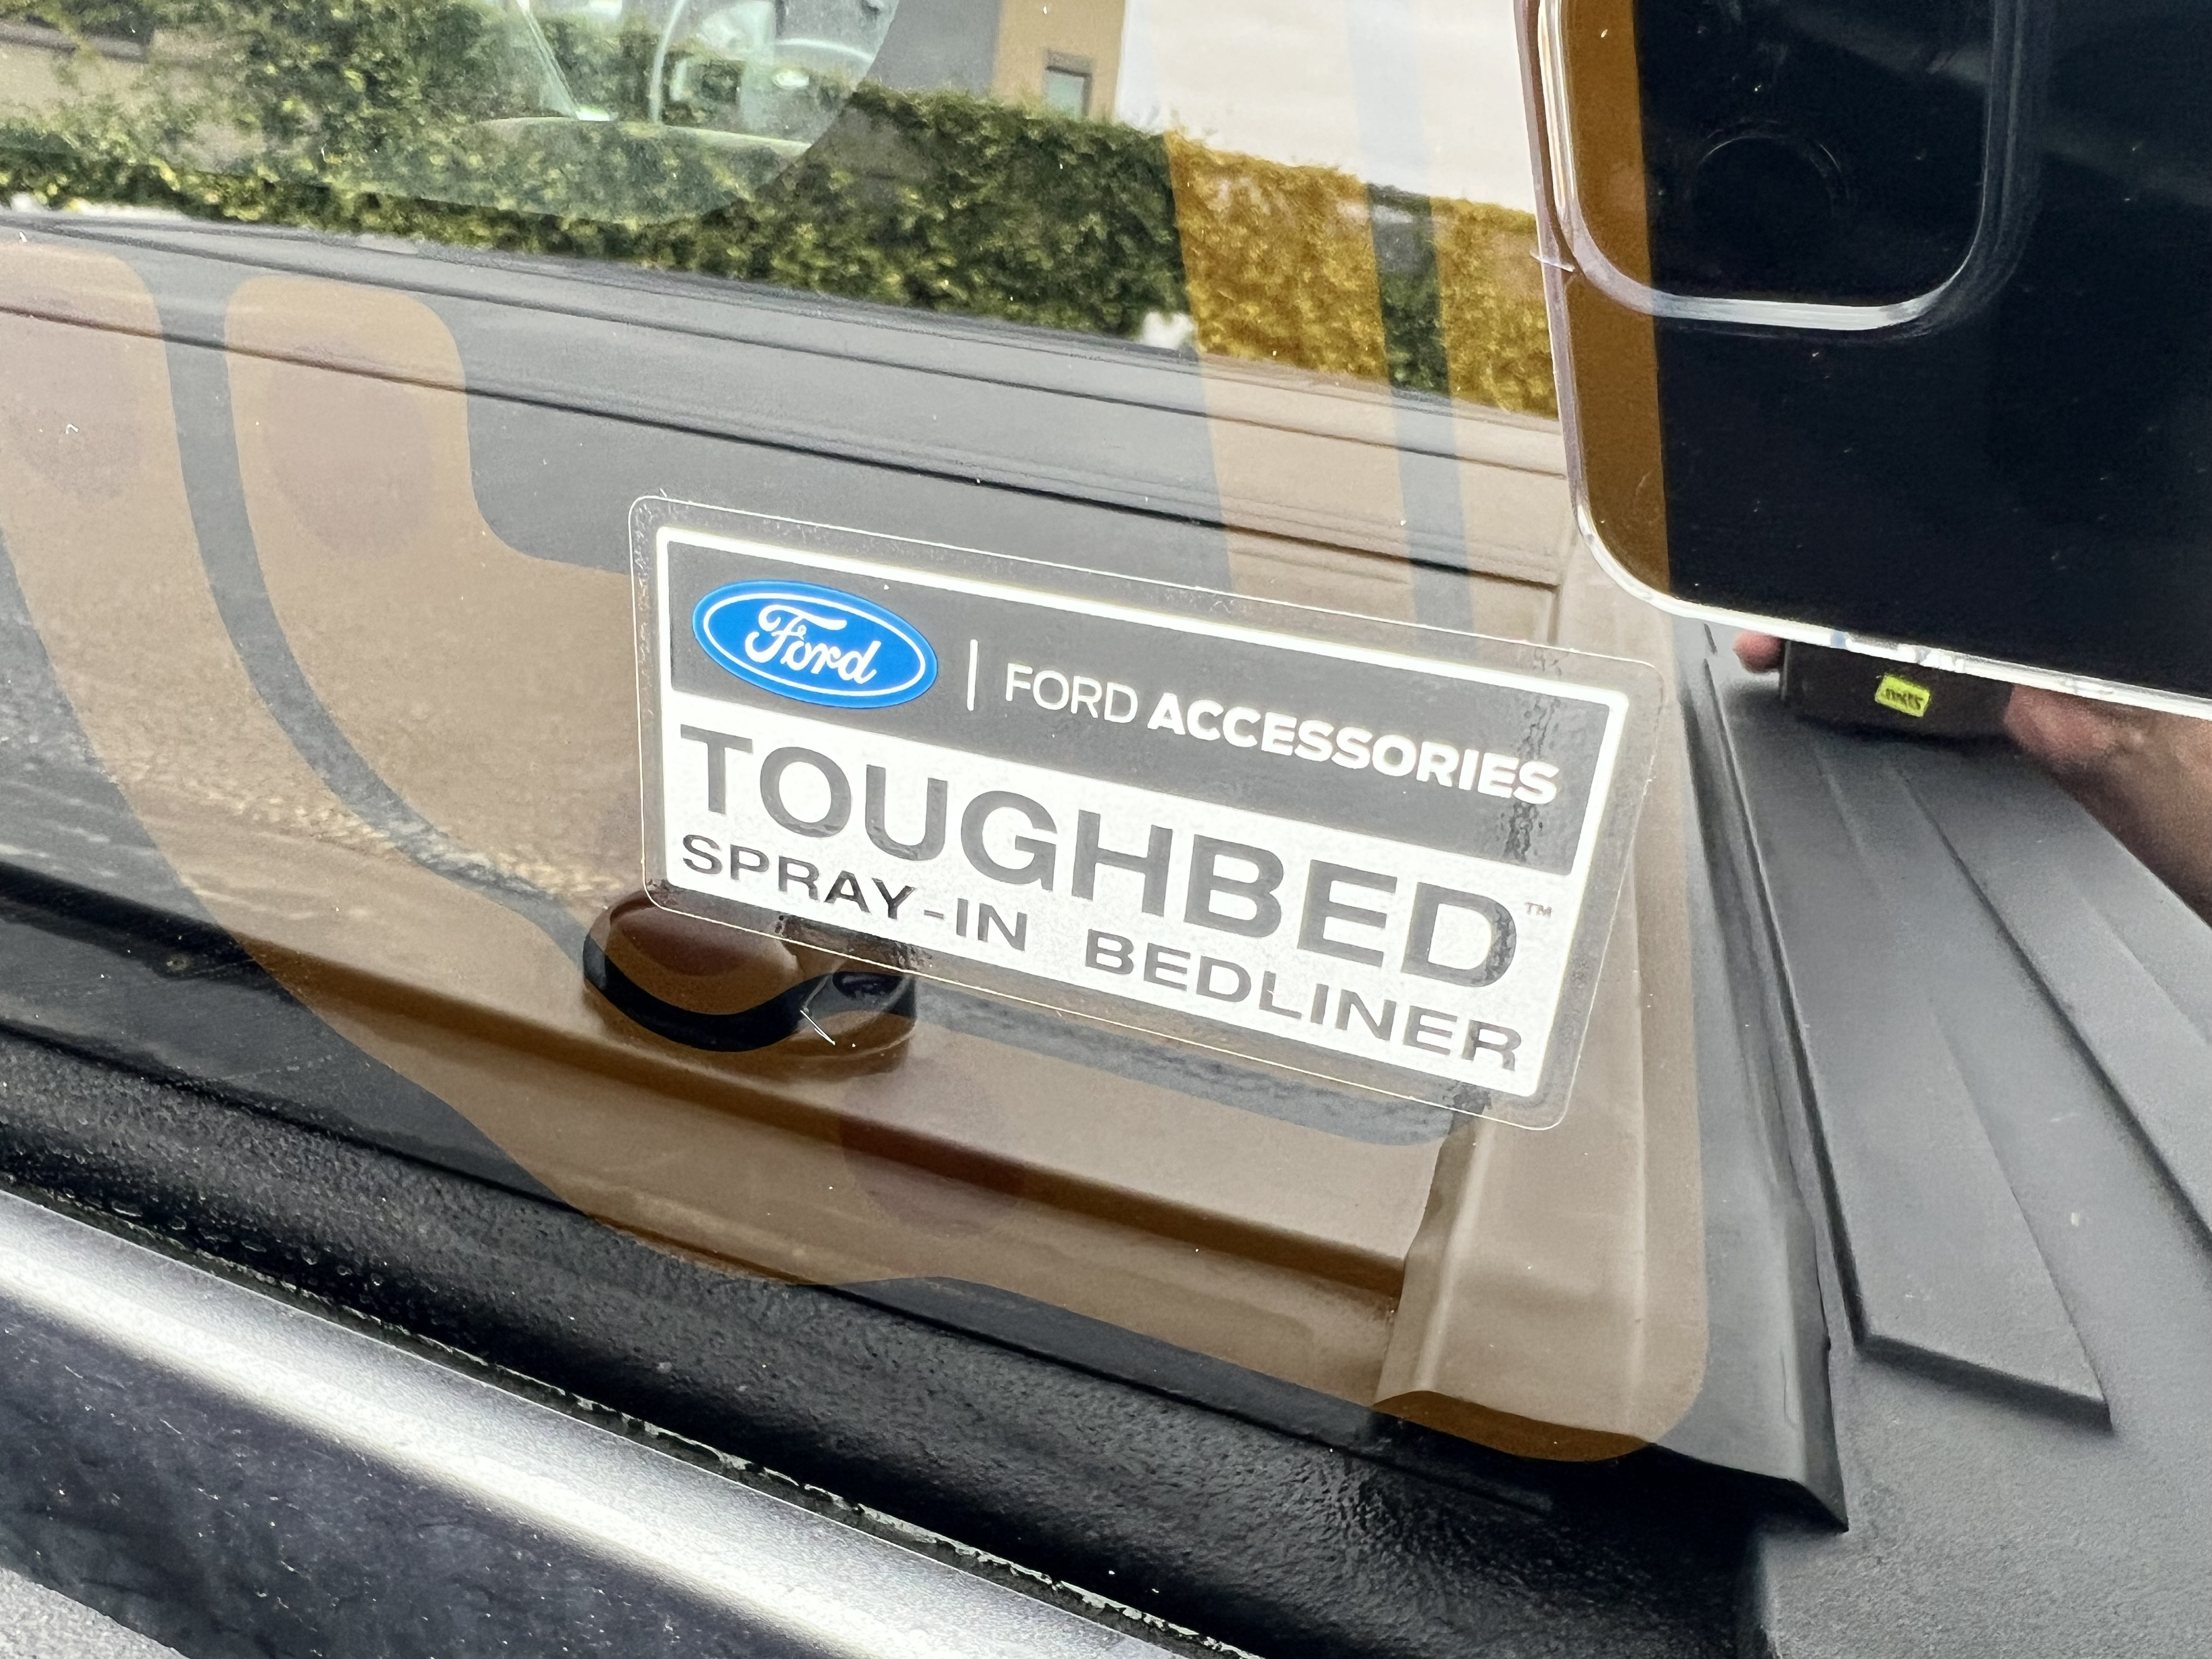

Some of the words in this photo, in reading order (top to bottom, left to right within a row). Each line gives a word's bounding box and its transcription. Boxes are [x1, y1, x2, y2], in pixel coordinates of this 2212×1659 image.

[744, 604, 881, 685] Ford
[1005, 662, 1138, 724] FORD
[1147, 693, 1560, 804] ACCESSORIES
[680, 724, 1517, 988] TOUGHBED
[682, 834, 1028, 950] SPRAY-IN
[1085, 929, 1522, 1071] BEDLINER
